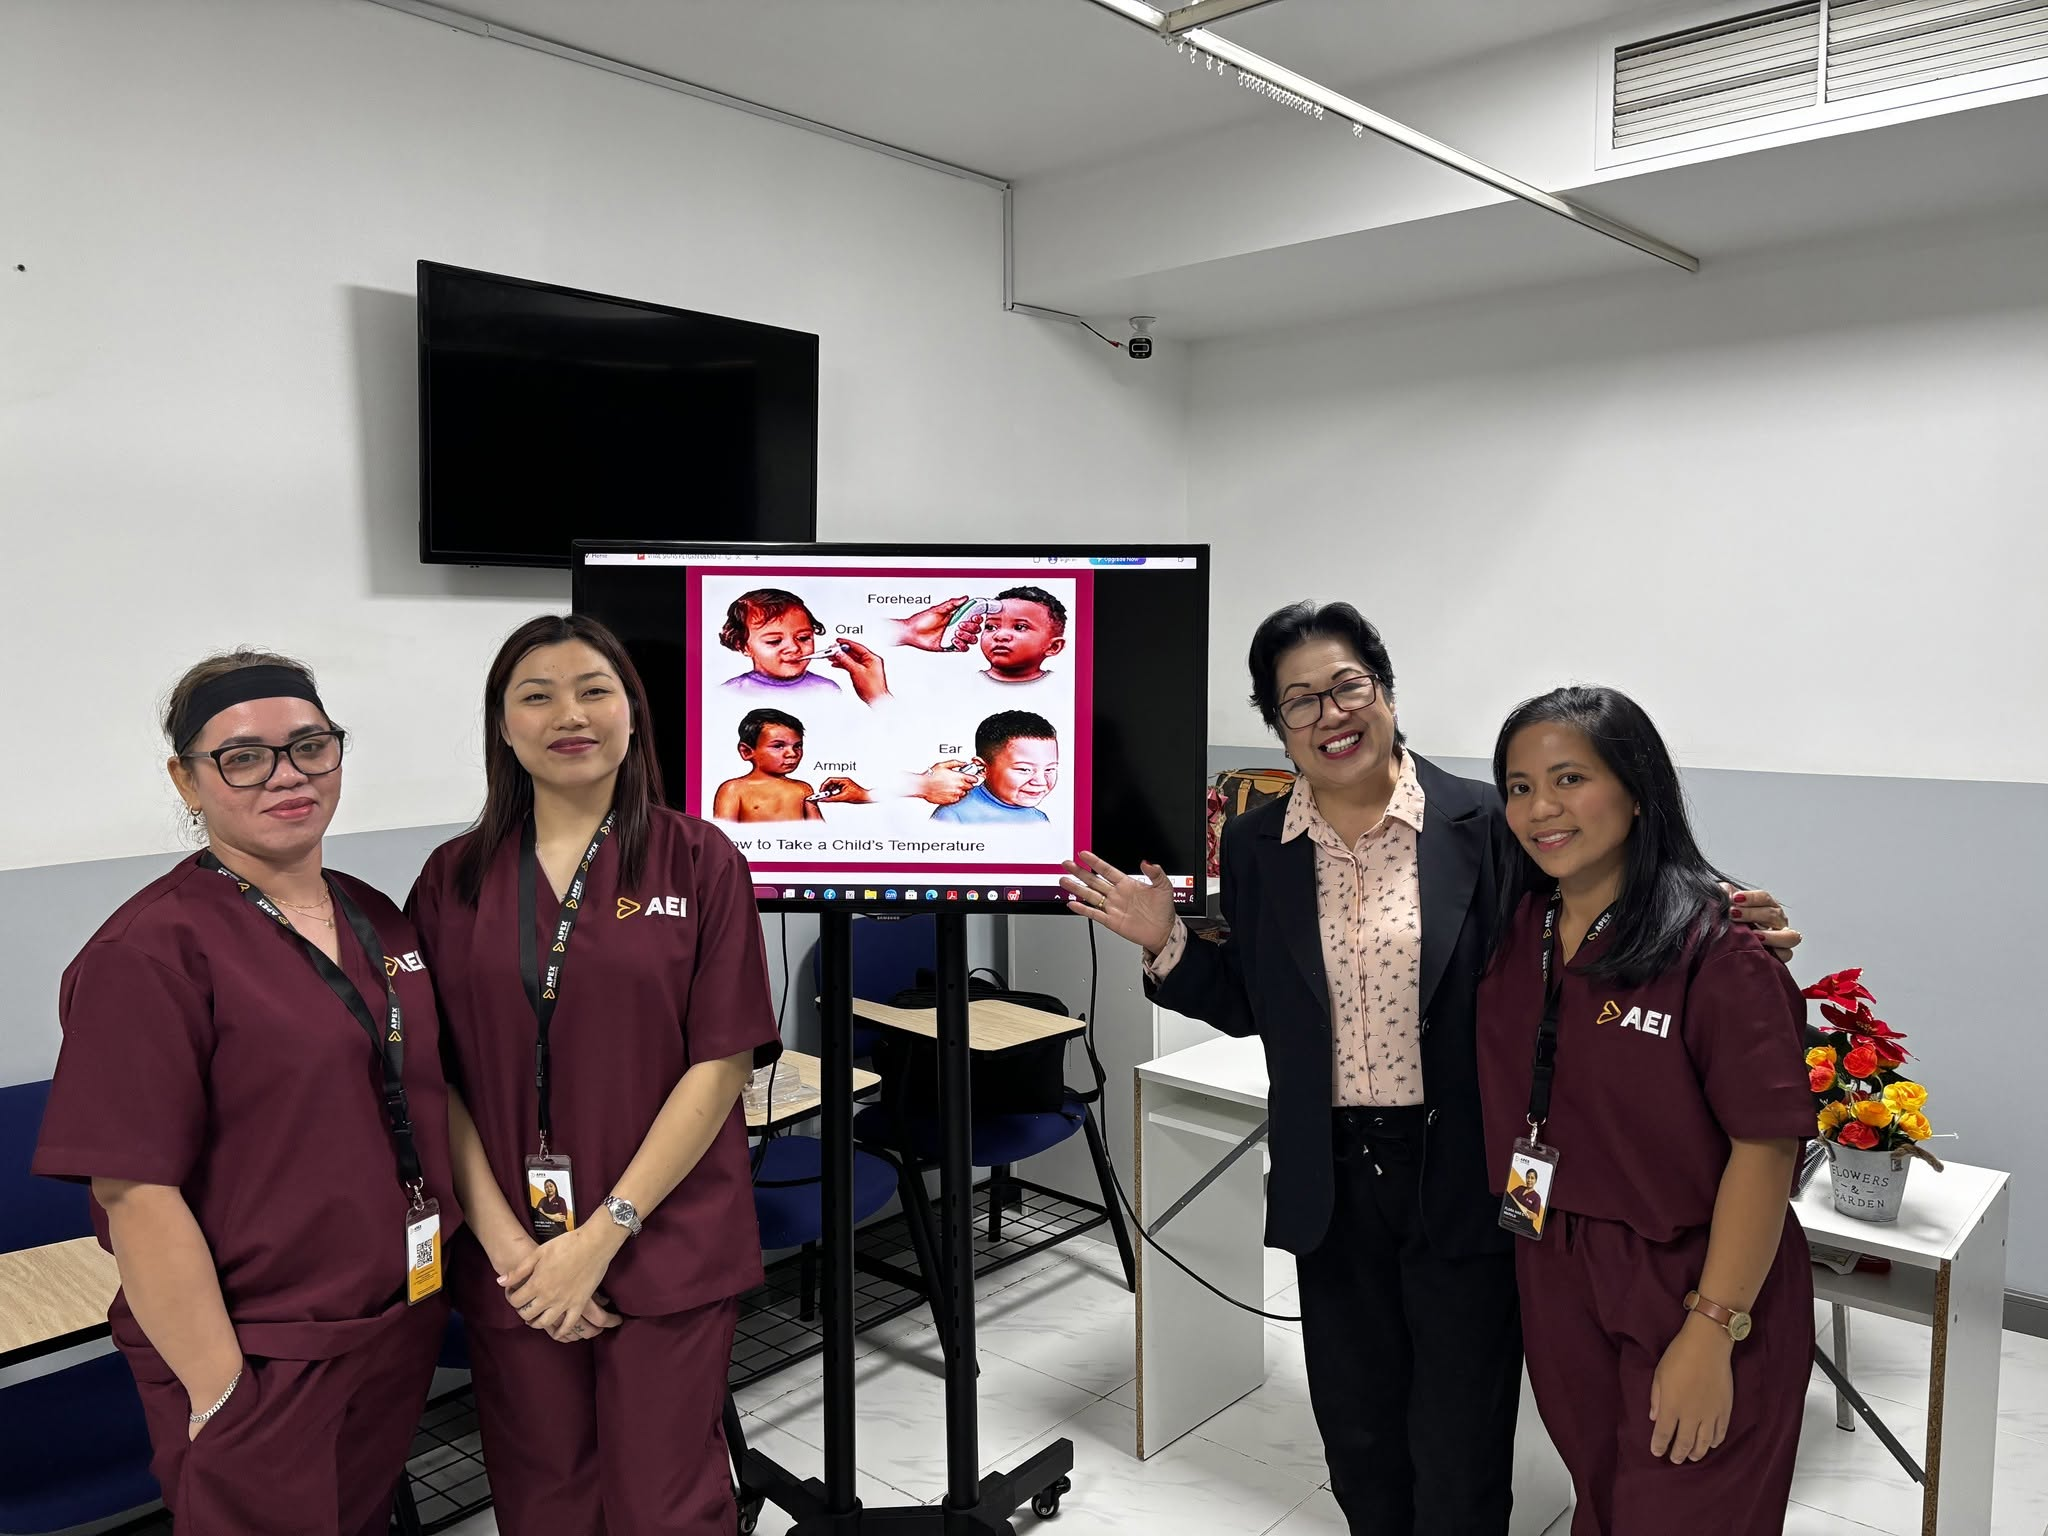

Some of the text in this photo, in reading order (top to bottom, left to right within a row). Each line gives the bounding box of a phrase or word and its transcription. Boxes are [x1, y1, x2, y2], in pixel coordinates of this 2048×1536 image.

[867, 594, 931, 604] Forehead
[835, 624, 863, 634] Oral
[939, 744, 963, 754] Ear
[813, 761, 857, 773] Armpit
[586, 842, 599, 860] APEX
[731, 839, 985, 853] ow to Take a Child's Temperature
[571, 879, 582, 899] APEX
[256, 899, 279, 916] APEX
[644, 895, 688, 918] AEI
[557, 920, 569, 941] APEX
[1595, 912, 1612, 932] APEX
[546, 965, 556, 988] APEX
[390, 1007, 398, 1029] APEX
[1620, 1006, 1672, 1038] AEI
[1831, 1164, 1890, 1187] FLOWERS
[1833, 1188, 1885, 1209] GARDEN
[1850, 1185, 1860, 1195] &
